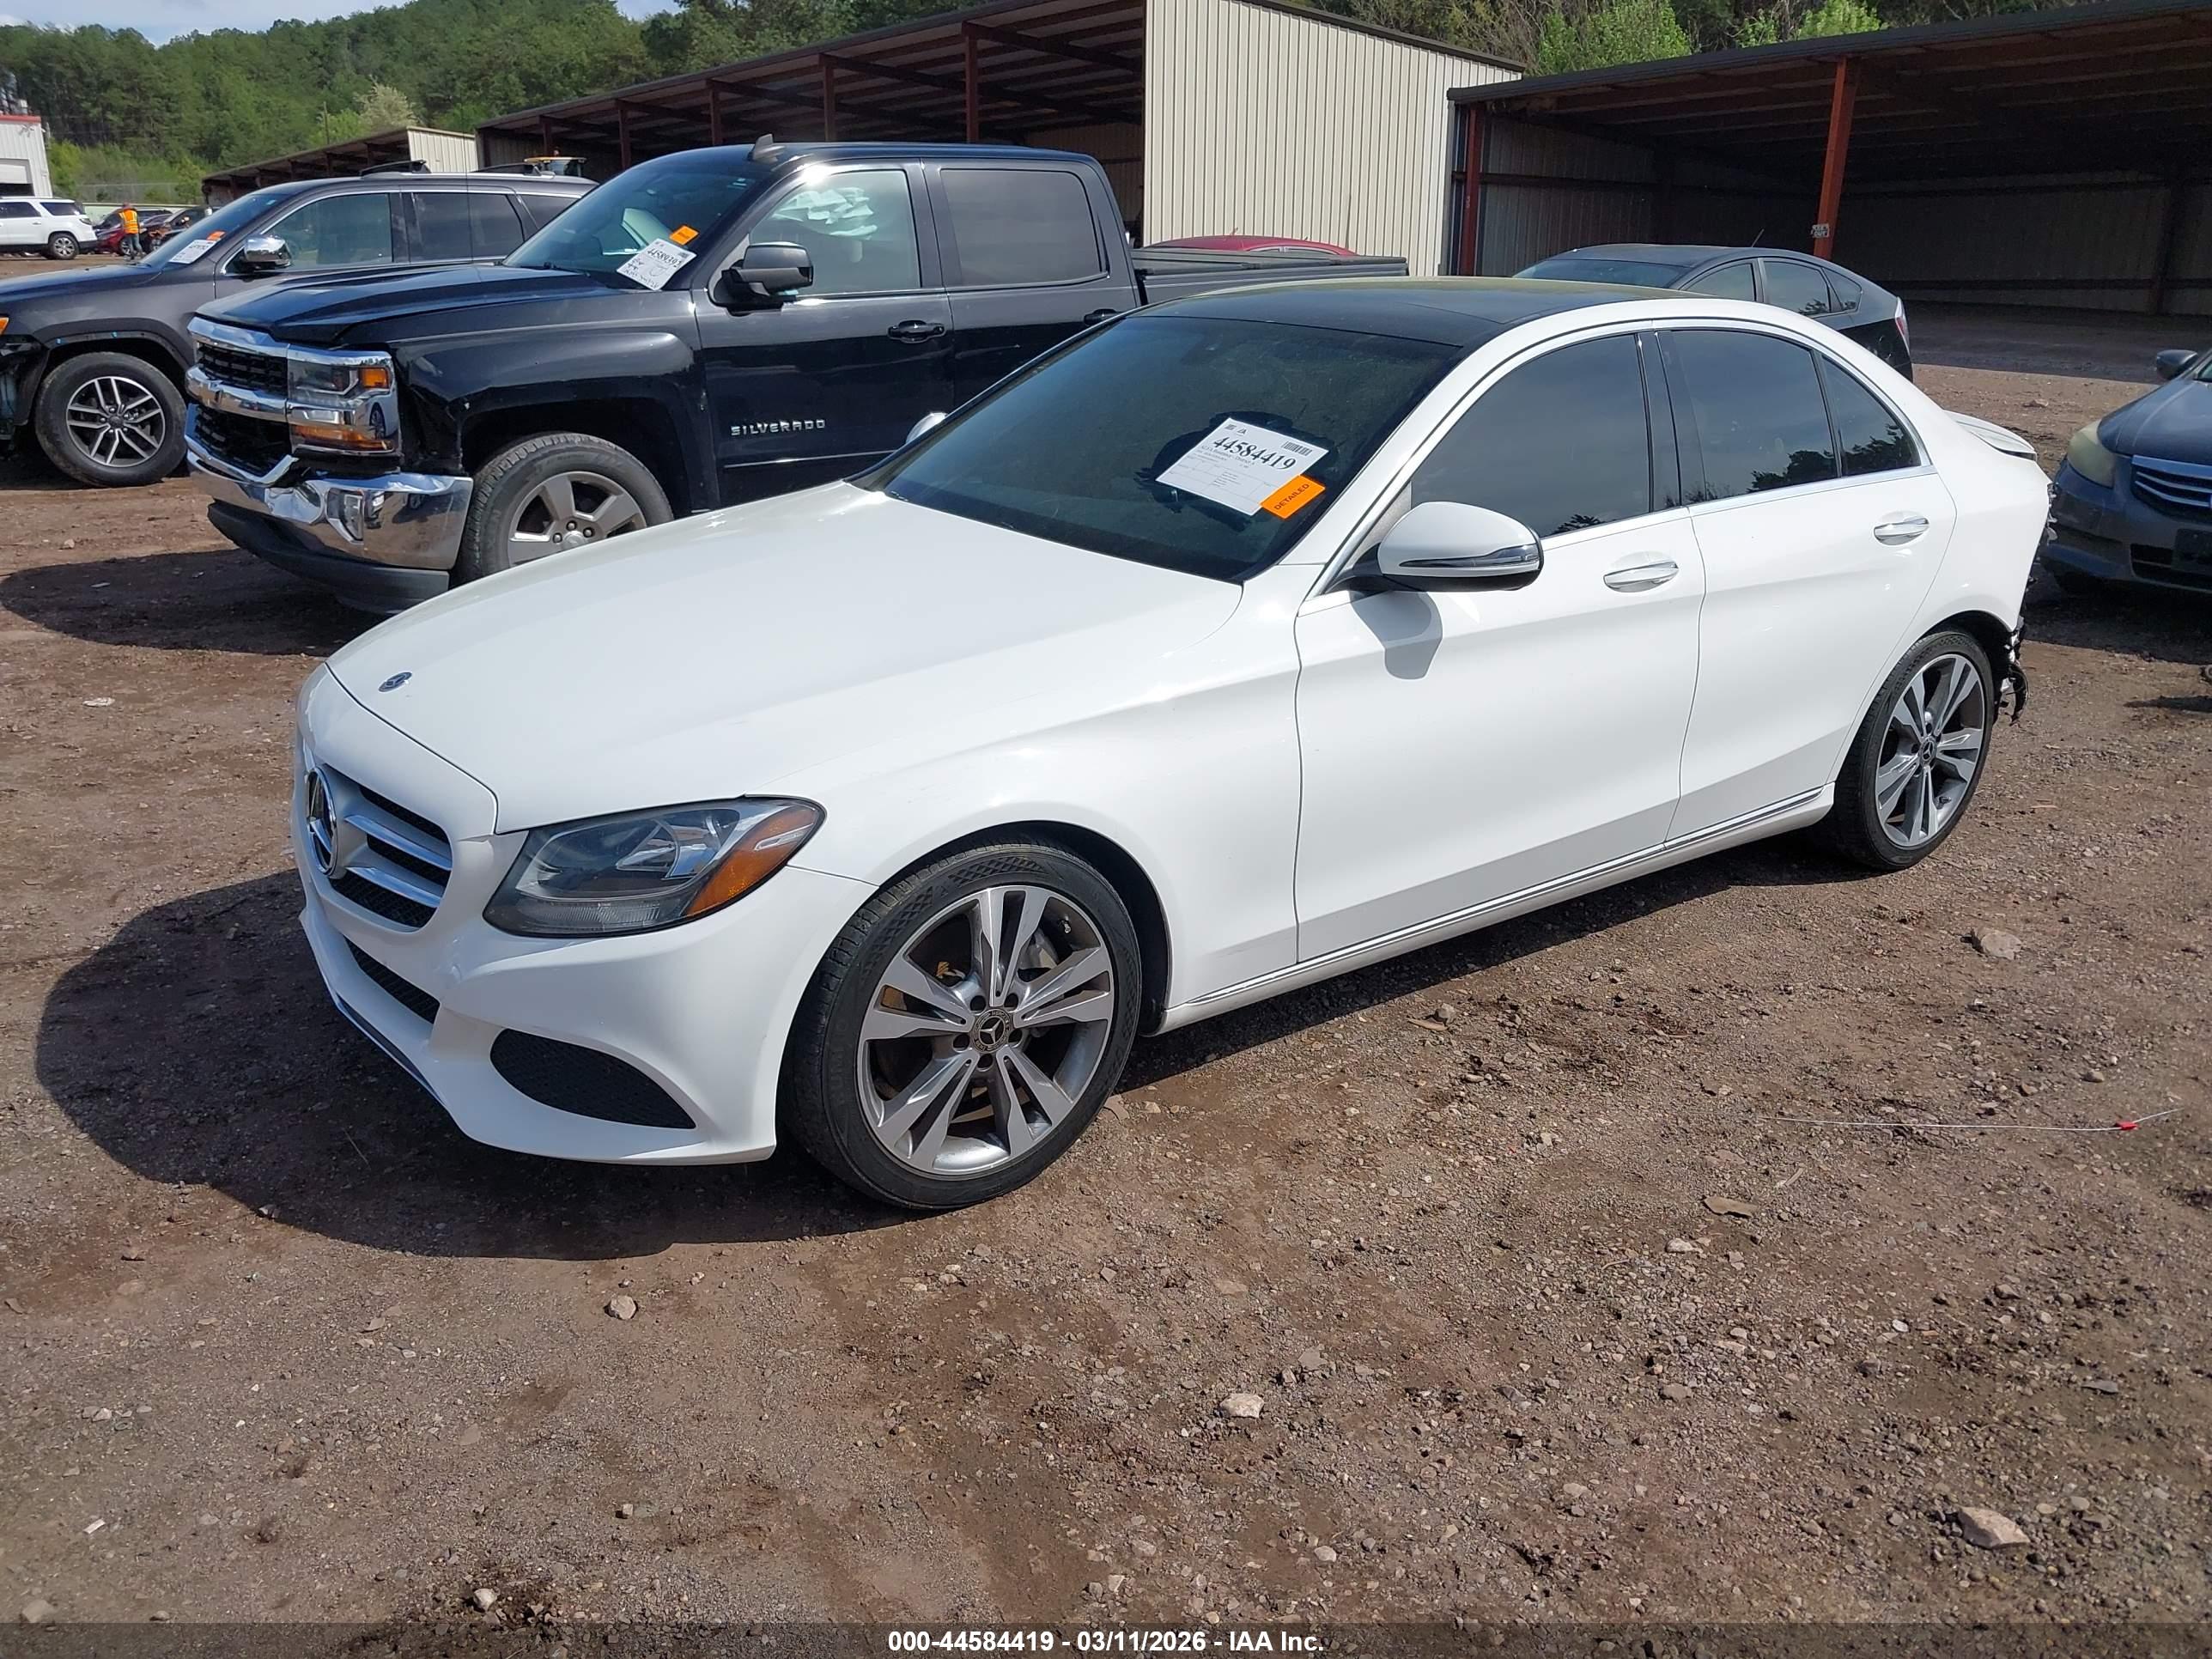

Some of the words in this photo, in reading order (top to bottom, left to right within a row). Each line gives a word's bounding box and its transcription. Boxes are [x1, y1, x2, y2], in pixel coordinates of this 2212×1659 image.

[731, 419, 825, 436] SILVERADO
[1213, 436, 1297, 471] 44584419
[1273, 483, 1310, 511] DETAILED
